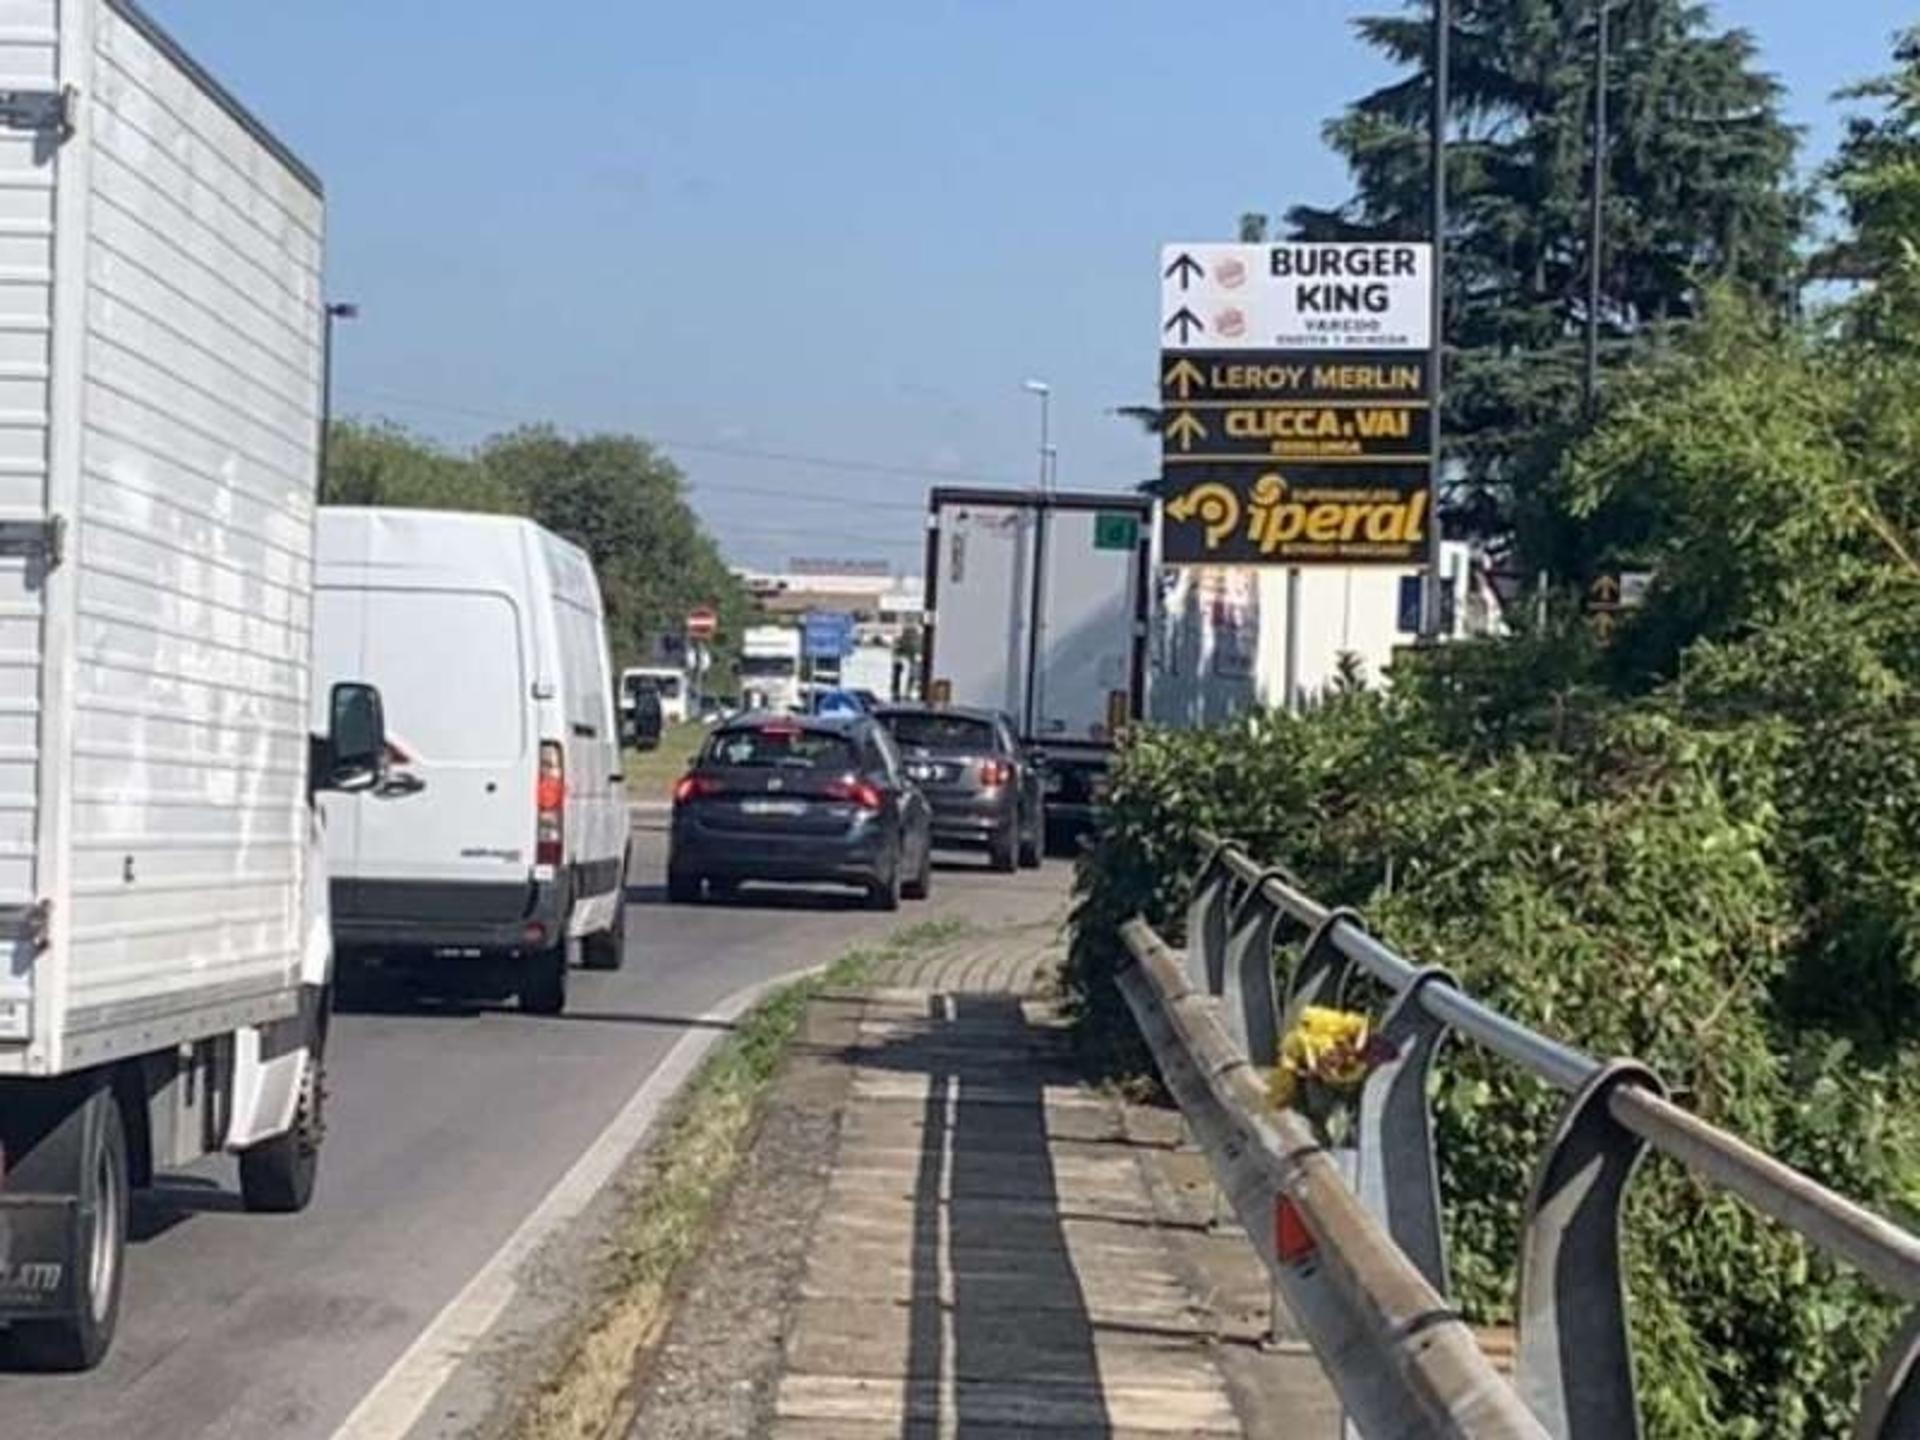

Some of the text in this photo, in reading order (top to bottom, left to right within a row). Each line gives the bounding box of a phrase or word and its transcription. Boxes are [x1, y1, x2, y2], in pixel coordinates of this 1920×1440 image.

[1270, 248, 1416, 277] BURGER
[1296, 283, 1390, 313] KING
[1211, 365, 1421, 389] LEROY MERLIN
[1247, 473, 1428, 554] iperal
